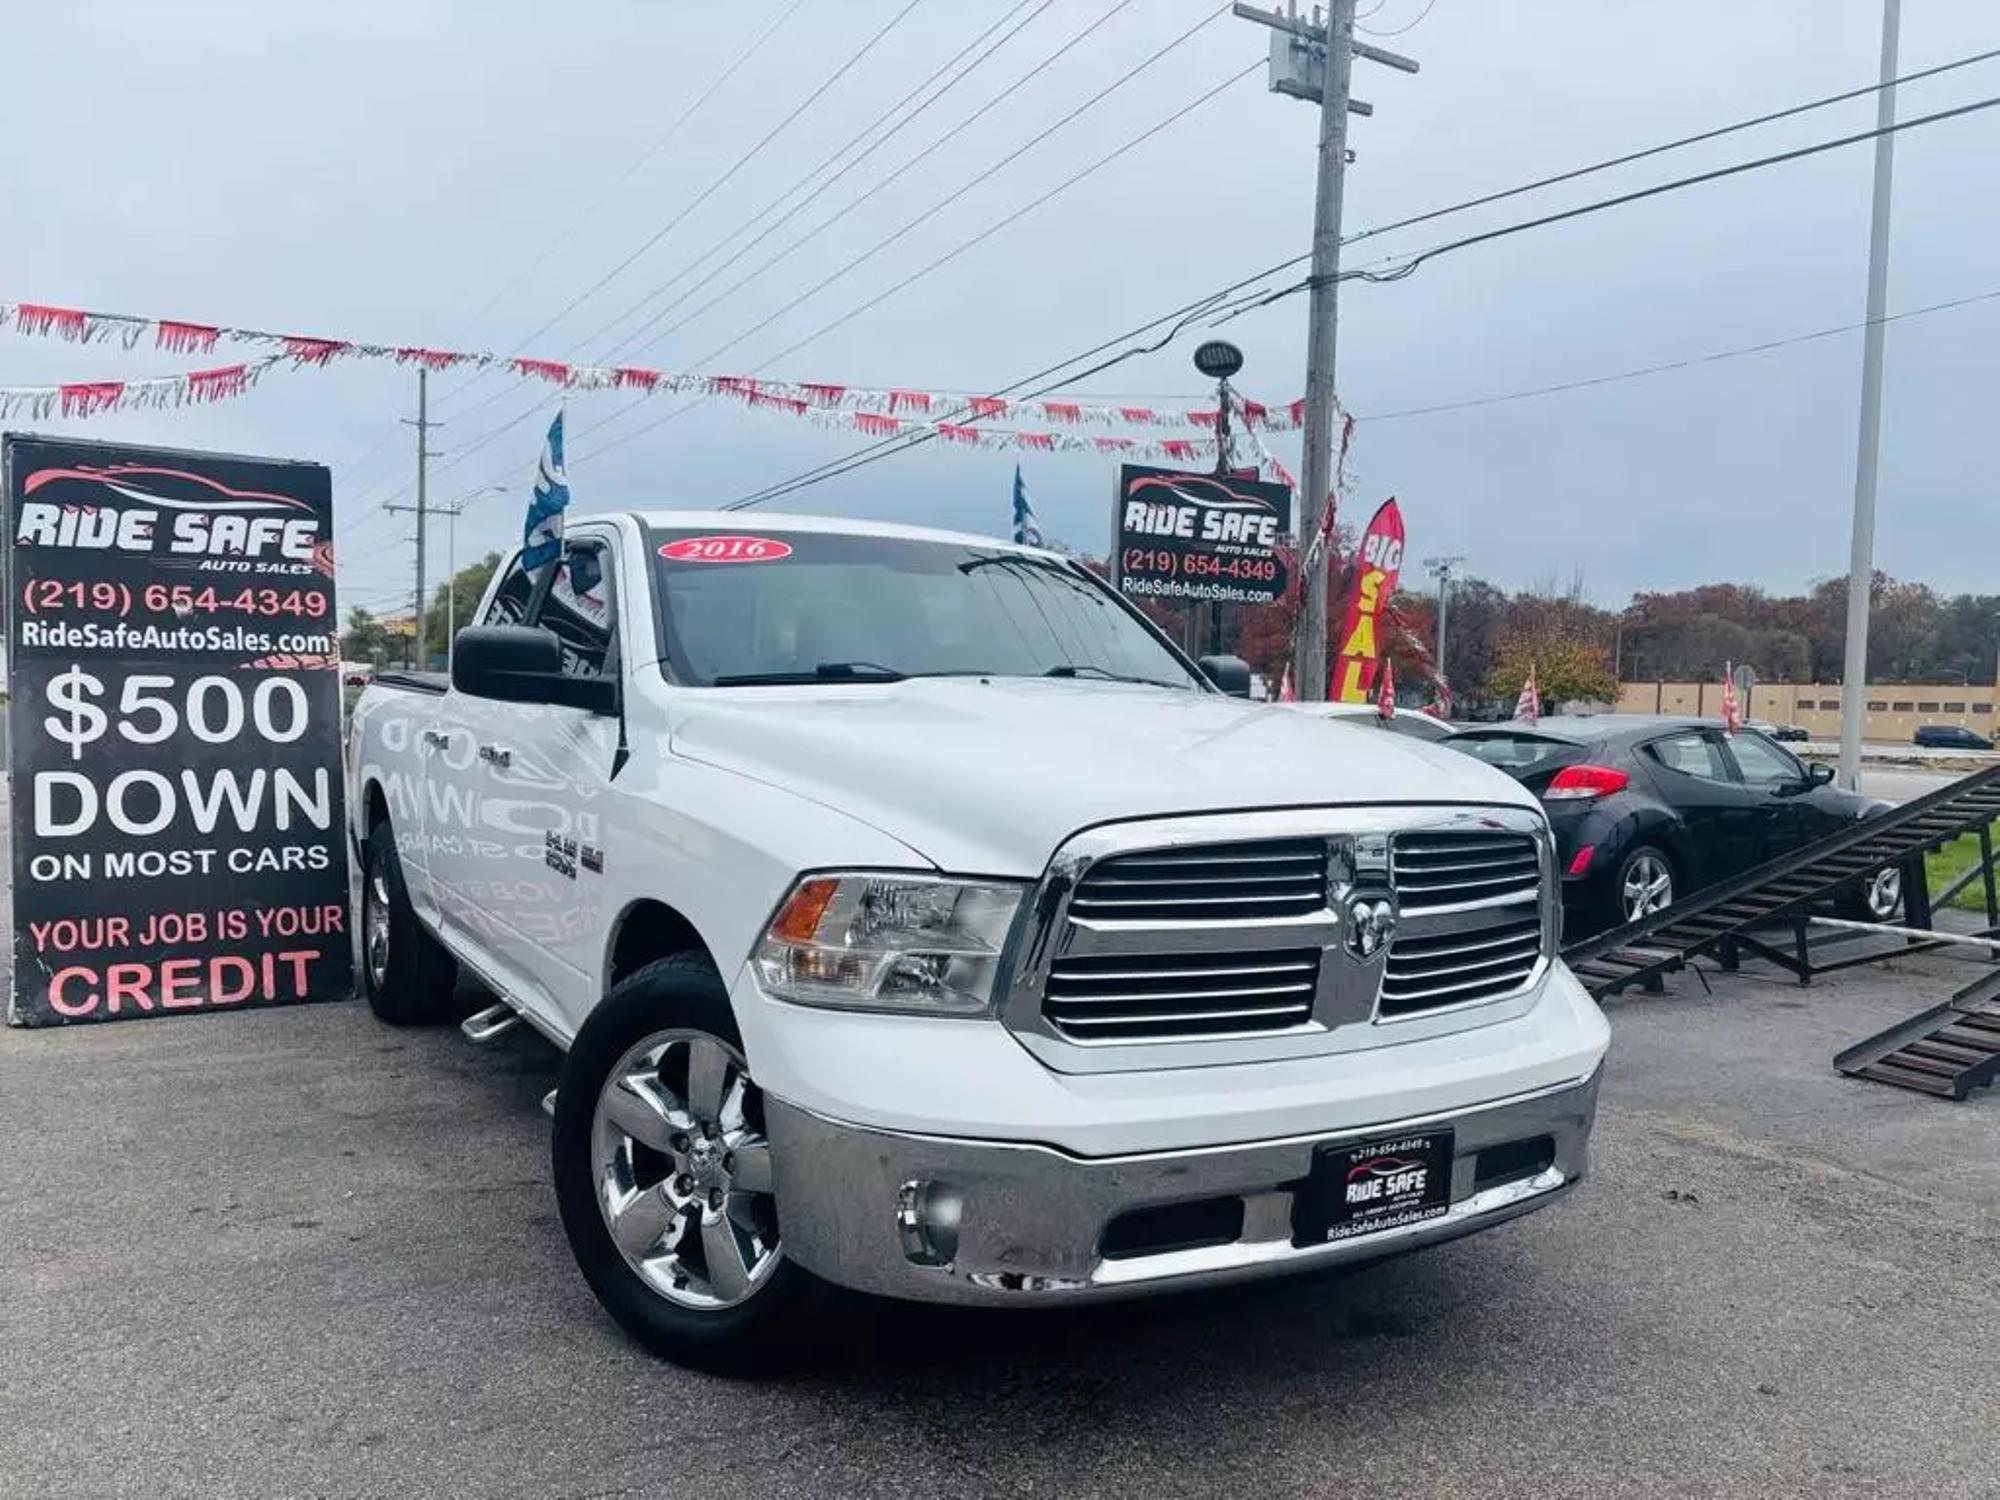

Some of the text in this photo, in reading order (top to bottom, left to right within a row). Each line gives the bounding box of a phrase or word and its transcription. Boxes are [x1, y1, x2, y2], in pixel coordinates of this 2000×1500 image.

[17, 502, 319, 559] RIDE SAFE
[1124, 501, 1278, 546] RIDE SAFE
[200, 559, 313, 575] AUTO SALES
[682, 541, 766, 558] 2016
[1122, 549, 1276, 581] (219) 654-4349
[1214, 544, 1274, 558] AUTO SALES
[23, 579, 327, 617] (219) 654-4349
[1122, 577, 1274, 602] RideSafeAutoSales.com
[21, 620, 330, 653] RideSafeAutoSales.com
[1341, 567, 1386, 703] SAL
[43, 663, 309, 760] $500
[34, 767, 330, 836] DOWN
[30, 845, 329, 881] ON MOST CARS
[30, 905, 344, 952] YOUR JOB IS YOUR
[48, 949, 321, 1018] CREDIT
[1346, 1178, 1384, 1203] RIDE
[1385, 1169, 1428, 1197] SAFE
